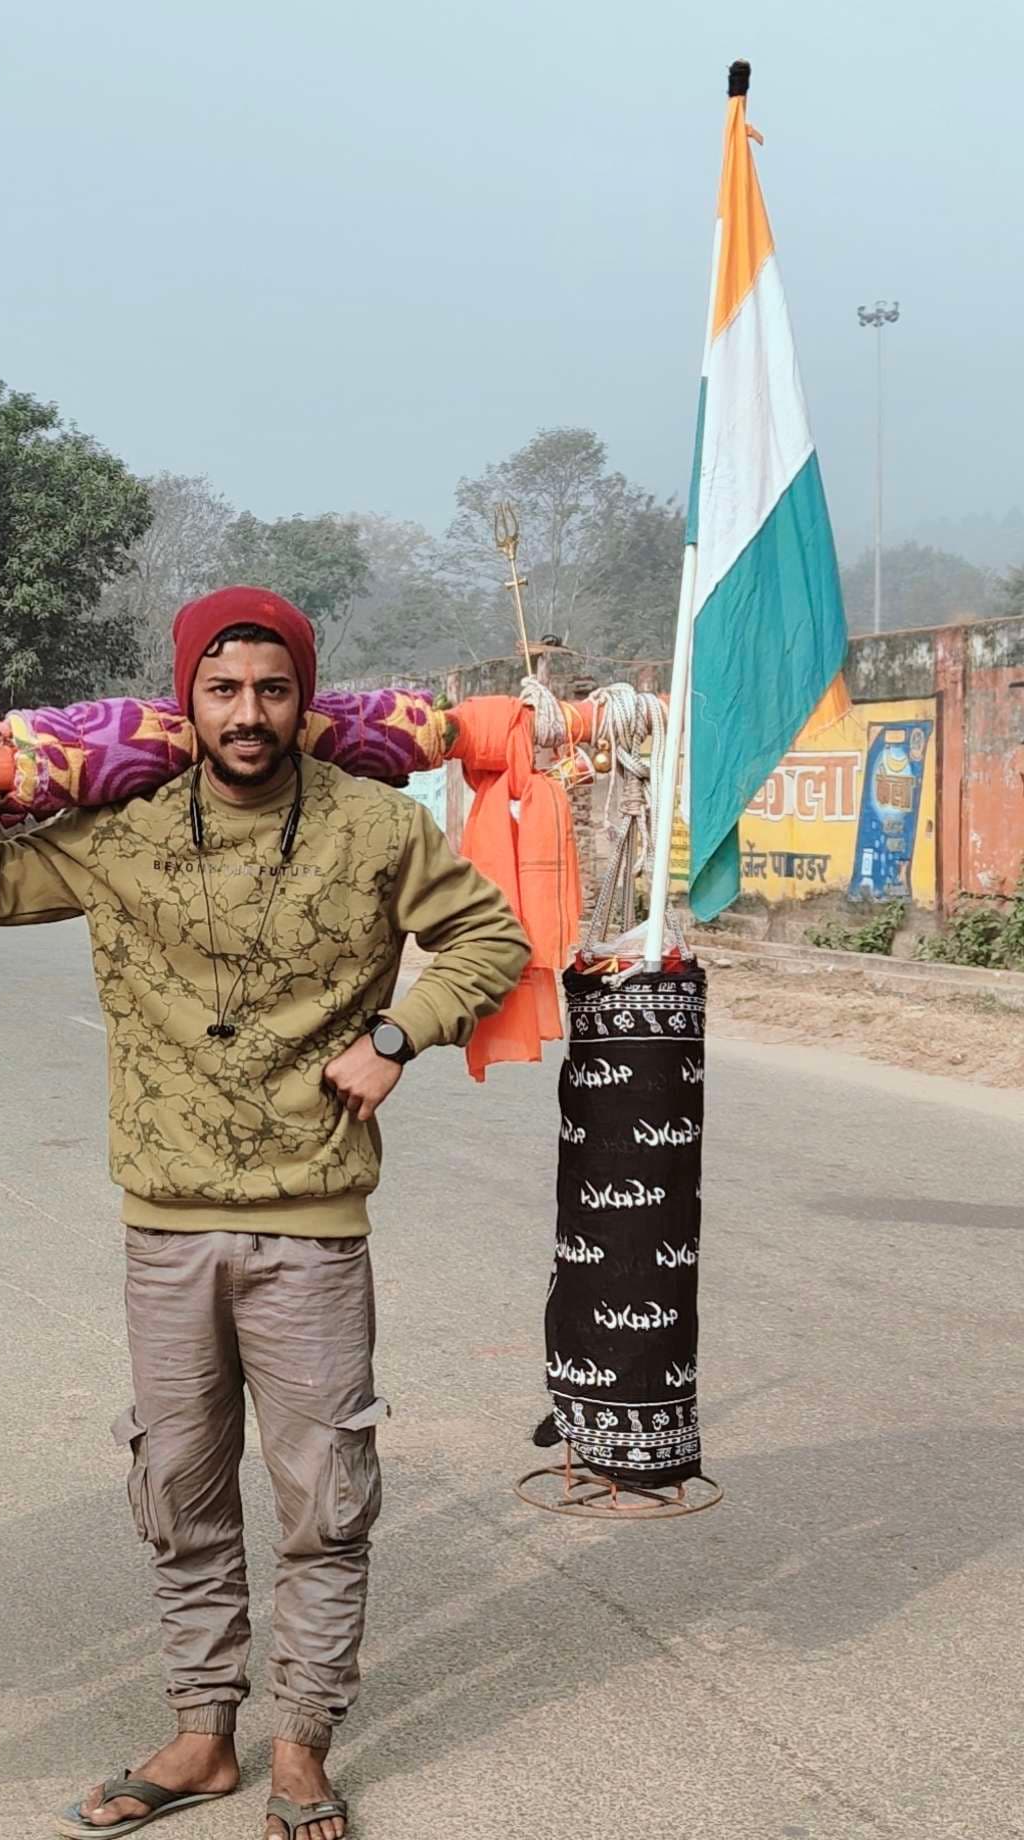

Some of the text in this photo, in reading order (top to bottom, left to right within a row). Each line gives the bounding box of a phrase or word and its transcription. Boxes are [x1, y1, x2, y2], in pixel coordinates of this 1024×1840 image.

[259, 866, 322, 877] FUTURE
[581, 1179, 666, 1209] महाकाल
[594, 1301, 679, 1331] महाकाल
